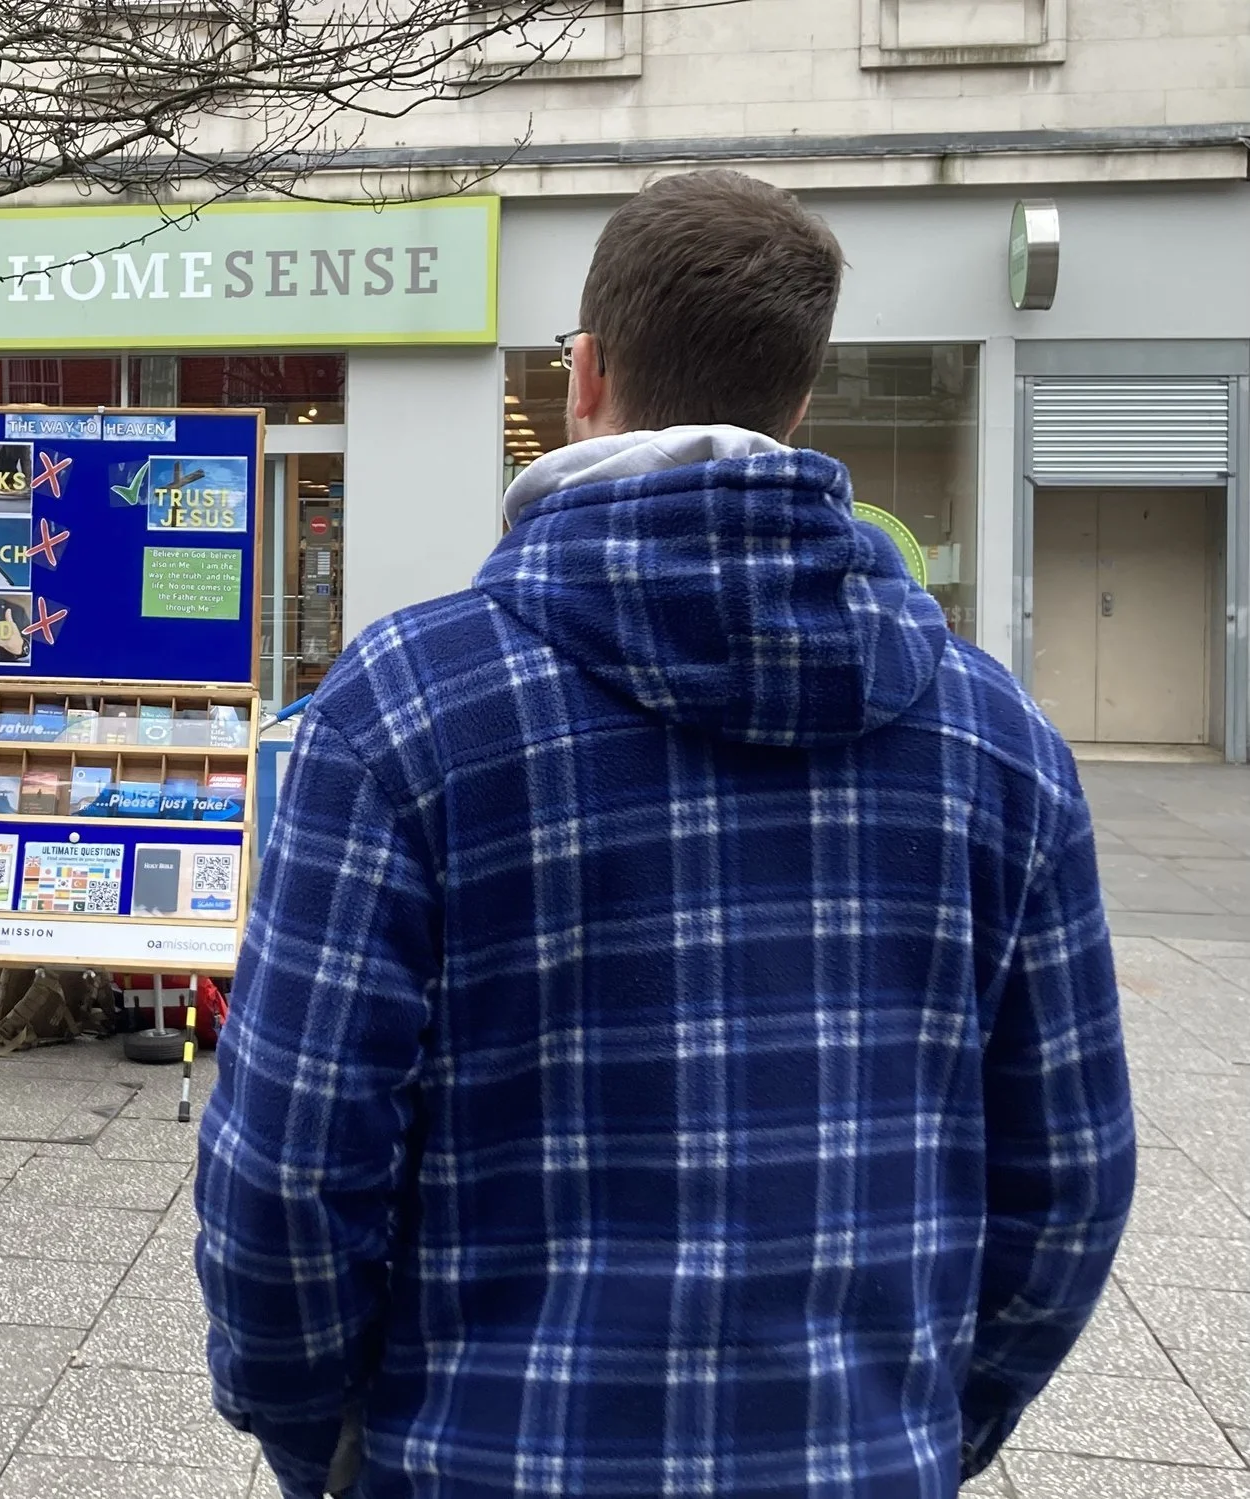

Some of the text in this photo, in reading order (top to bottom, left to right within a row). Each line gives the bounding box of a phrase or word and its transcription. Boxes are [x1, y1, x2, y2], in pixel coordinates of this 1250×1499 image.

[7, 247, 439, 301] HOMESENSE
[9, 421, 165, 435] THE WAY TO HEAVEN
[155, 488, 229, 507] TRUST
[160, 509, 234, 527] JESUS
[210, 551, 237, 560] believe
[223, 573, 236, 581] the
[168, 582, 179, 590] No
[172, 593, 197, 601] Father
[199, 595, 224, 603] except
[165, 604, 196, 613] through
[160, 796, 187, 811] just
[193, 798, 228, 810] take!
[42, 846, 121, 856] ULTIMATE QUESTIONS
[1, 927, 54, 937] MISSION
[147, 939, 234, 952] oamission.com
